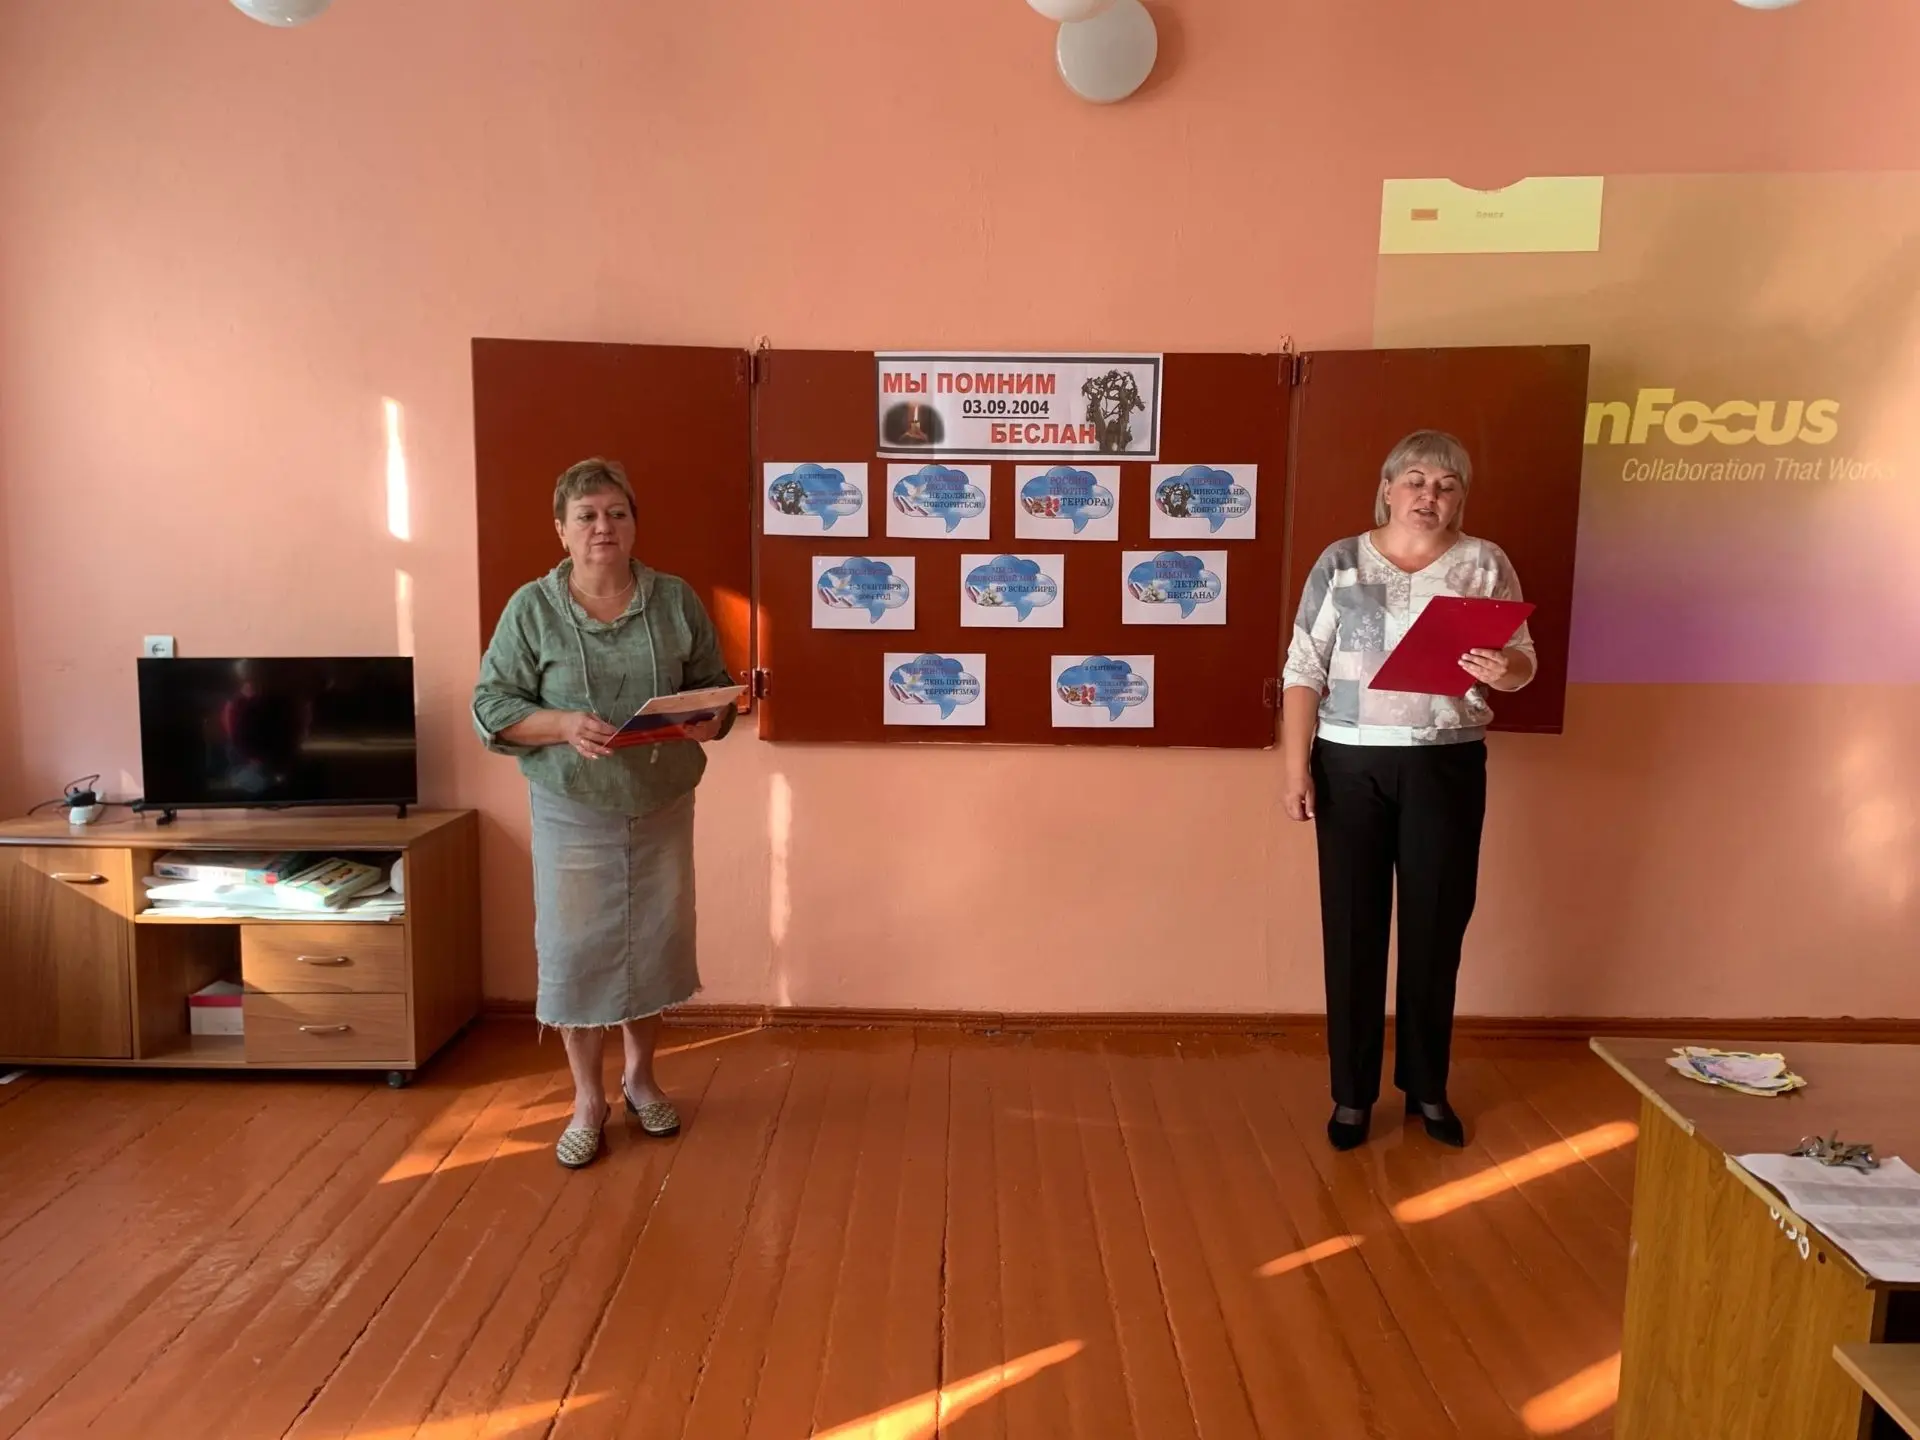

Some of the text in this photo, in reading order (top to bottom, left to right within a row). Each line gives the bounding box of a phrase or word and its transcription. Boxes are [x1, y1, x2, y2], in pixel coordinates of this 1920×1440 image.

[883, 372, 1056, 394] МЫ ПОМНИМ
[963, 399, 1050, 415] 03.09.2004
[1583, 388, 1840, 445] nFocus
[990, 423, 1096, 444] БЕСЛАН
[1622, 457, 1766, 482] Collaboration
[1774, 456, 1821, 481] That
[1061, 497, 1110, 506] ТЕРРОРА!
[1167, 591, 1216, 599] БЕСЛАНА!
